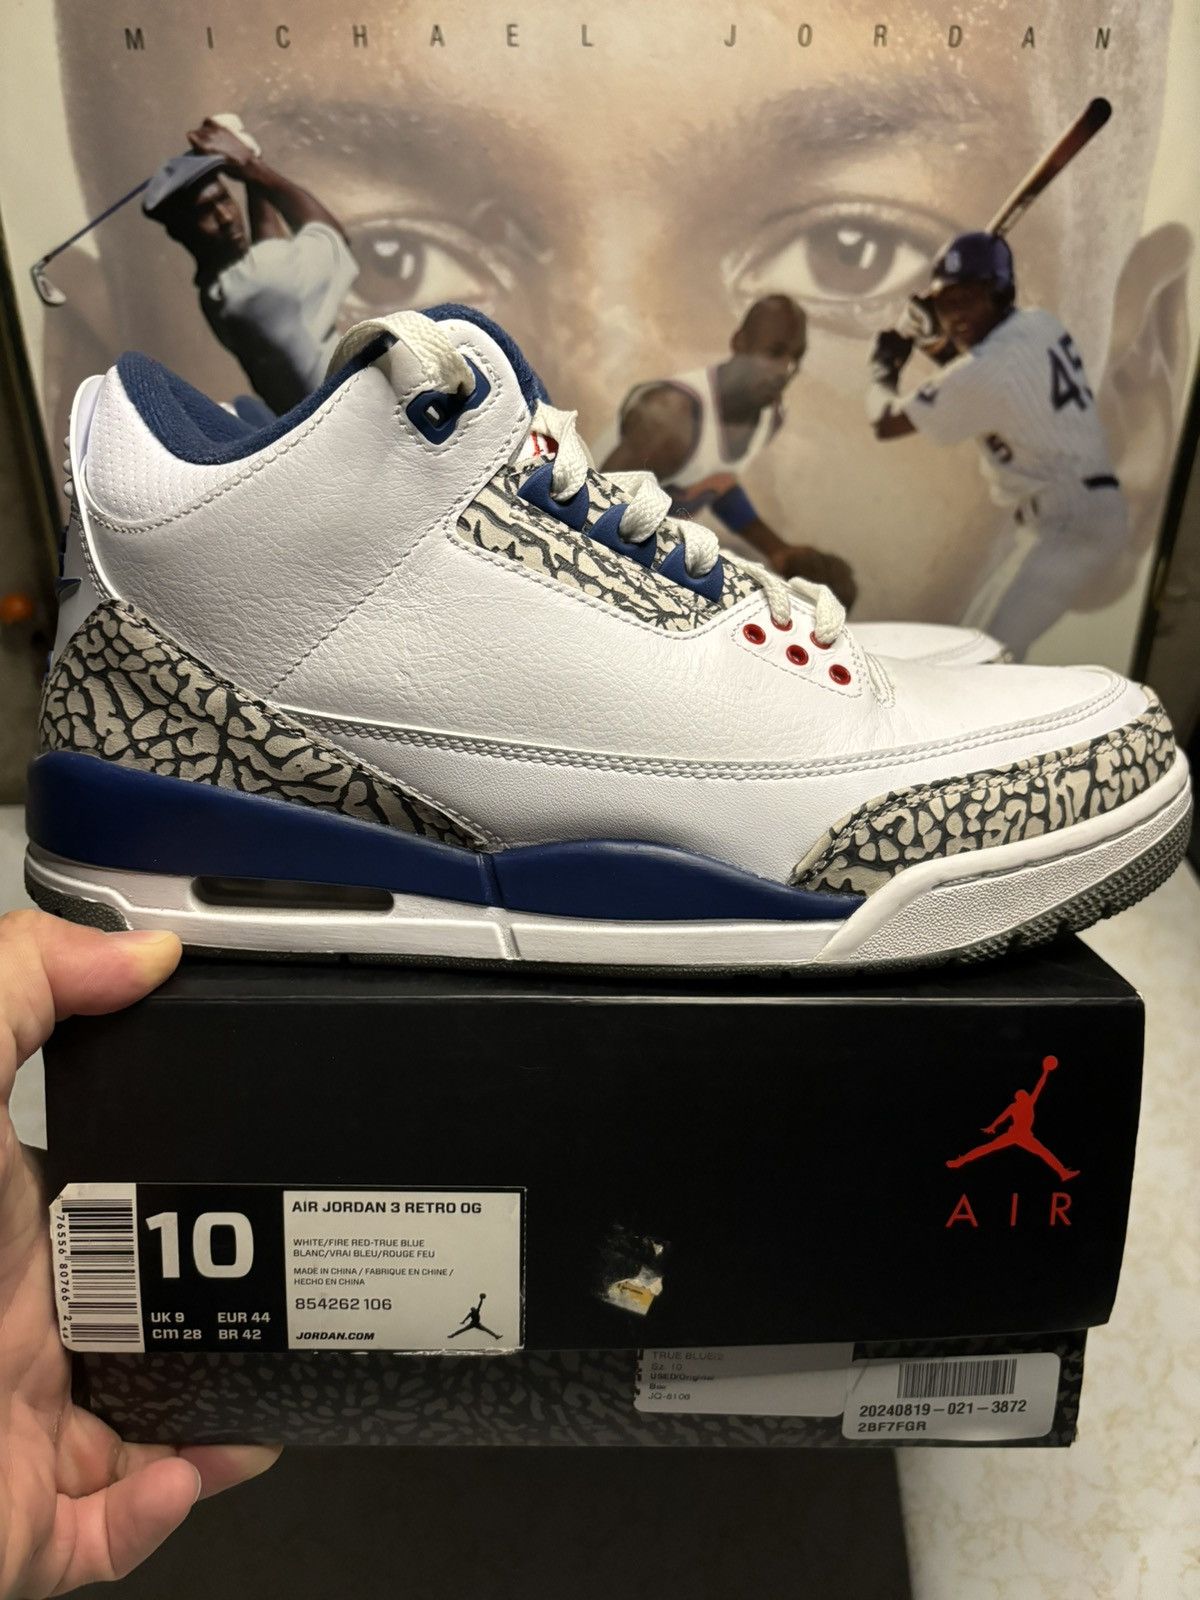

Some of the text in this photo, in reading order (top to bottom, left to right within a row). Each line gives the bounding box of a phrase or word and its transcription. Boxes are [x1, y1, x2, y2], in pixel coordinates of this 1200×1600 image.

[124, 23, 1112, 51] MICHAEL JORDAN
[292, 1201, 482, 1214] AIR JORDAN 3 RETRO OG
[946, 1191, 1072, 1228] AIR
[56, 1214, 67, 1255] 76556
[145, 1211, 254, 1278] 10
[293, 1239, 425, 1248] WHITE/FIRE RED-TRUE BLUE
[293, 1249, 436, 1258] BLANC/VRAI BLEU/ROUGE FEU
[365, 1268, 406, 1276] FABRIQUE
[408, 1268, 420, 1276] EN
[422, 1268, 448, 1276] CHINE
[59, 1263, 71, 1302] 80766
[294, 1278, 366, 1286] HECHO EN CHINA
[295, 1298, 393, 1311] 854262 106
[150, 1312, 185, 1323] UK 9
[217, 1311, 271, 1323] EUR 44
[183, 1329, 202, 1340] 28
[219, 1329, 262, 1340] BR 42
[296, 1332, 375, 1341] JORDAN.COM
[857, 1420, 927, 1433] 2BF7FGR
